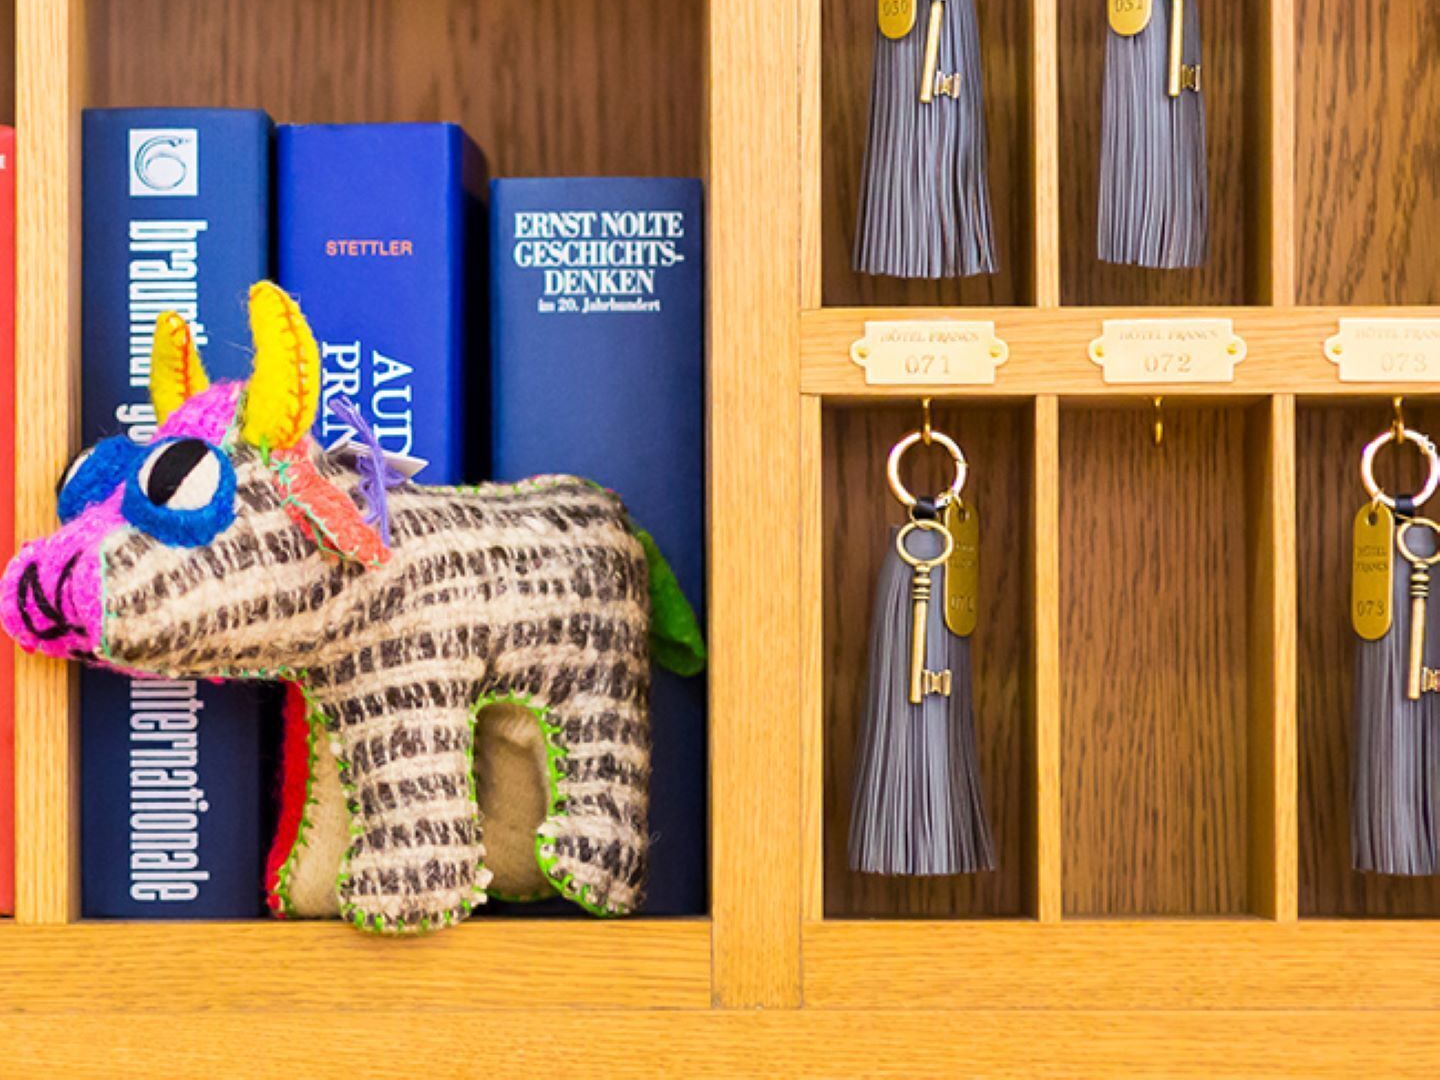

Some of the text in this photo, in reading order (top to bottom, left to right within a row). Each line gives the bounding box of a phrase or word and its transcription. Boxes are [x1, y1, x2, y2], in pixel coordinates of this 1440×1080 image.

[515, 212, 684, 238] ERNST NOLTE
[326, 241, 413, 257] STETTLER
[514, 241, 685, 267] GESCHICHTS-
[544, 270, 655, 295] DENKEN
[538, 297, 660, 313] im 20. Jahrhundert
[905, 354, 949, 375] 071
[1145, 353, 1191, 373] 072
[130, 679, 210, 901] nternationale
